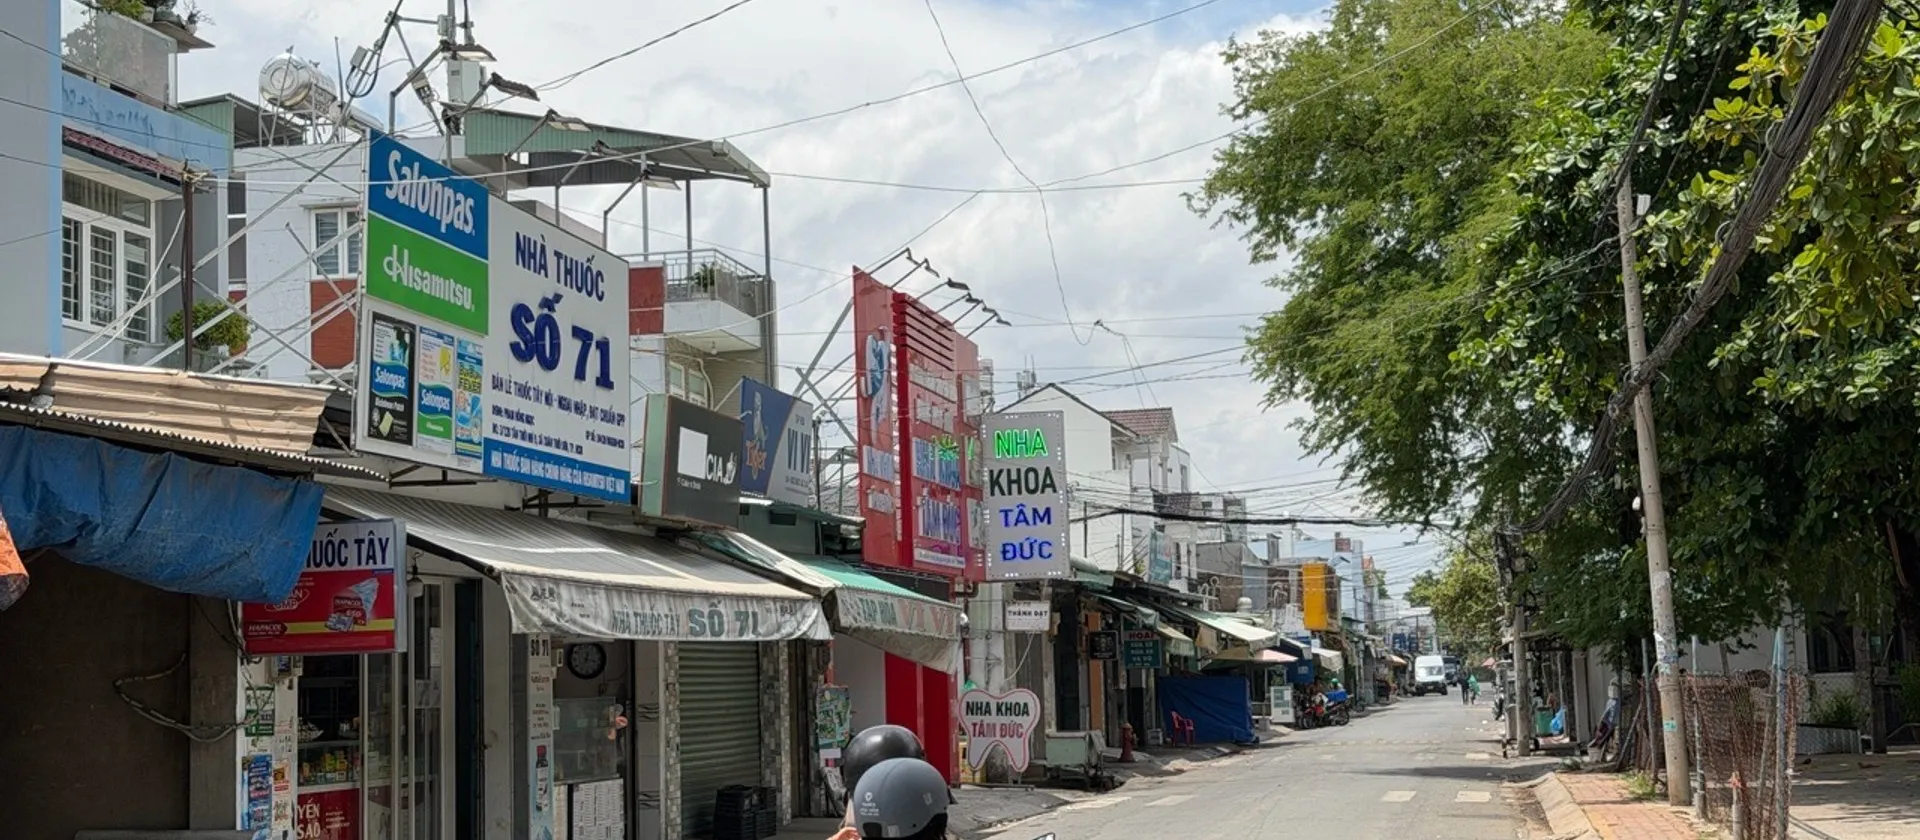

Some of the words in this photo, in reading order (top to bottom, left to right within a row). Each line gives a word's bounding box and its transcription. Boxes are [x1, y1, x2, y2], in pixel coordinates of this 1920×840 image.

[385, 150, 475, 234] Salonpas
[383, 244, 474, 311] Hisamitsu
[515, 231, 548, 279] NHÀ
[554, 250, 605, 302] THUỐC
[509, 292, 564, 371] SỐ
[571, 324, 614, 390] 71
[374, 366, 406, 390] Salonpas
[421, 388, 451, 412] Salonpas
[995, 429, 1048, 458] NHA
[989, 466, 1057, 497] KHOA
[1000, 504, 1052, 527] TÂM
[306, 528, 349, 568] UỐC
[354, 530, 389, 566] TÂY
[1001, 537, 1053, 561] ĐỨC
[633, 604, 663, 636] THUỐC
[688, 600, 725, 638] SỐ
[734, 611, 761, 638] 71
[966, 701, 992, 716] NHA
[995, 701, 1030, 717] KHOA
[971, 719, 997, 738] TÂM
[999, 719, 1025, 738] ĐỨC
